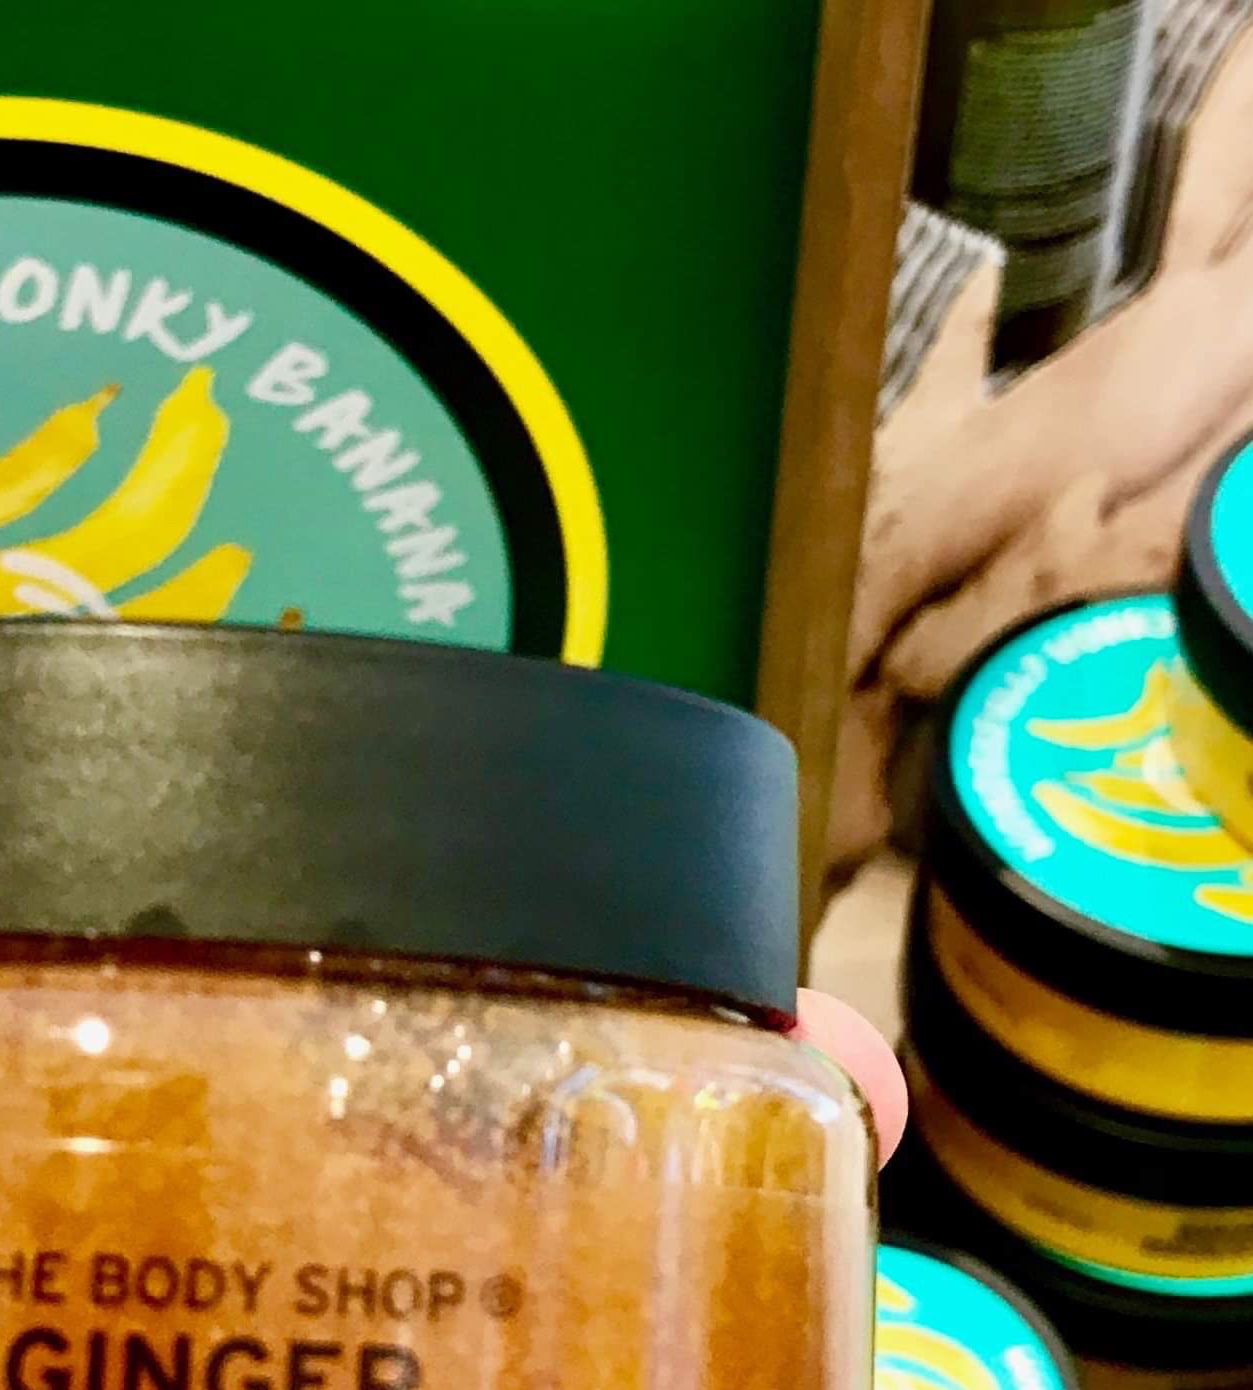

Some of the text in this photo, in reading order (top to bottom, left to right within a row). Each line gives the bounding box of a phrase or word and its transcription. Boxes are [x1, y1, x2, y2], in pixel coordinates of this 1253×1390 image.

[246, 342, 475, 628] BANANA
[91, 1251, 272, 1314] BODY
[294, 1262, 466, 1322] SHOP
